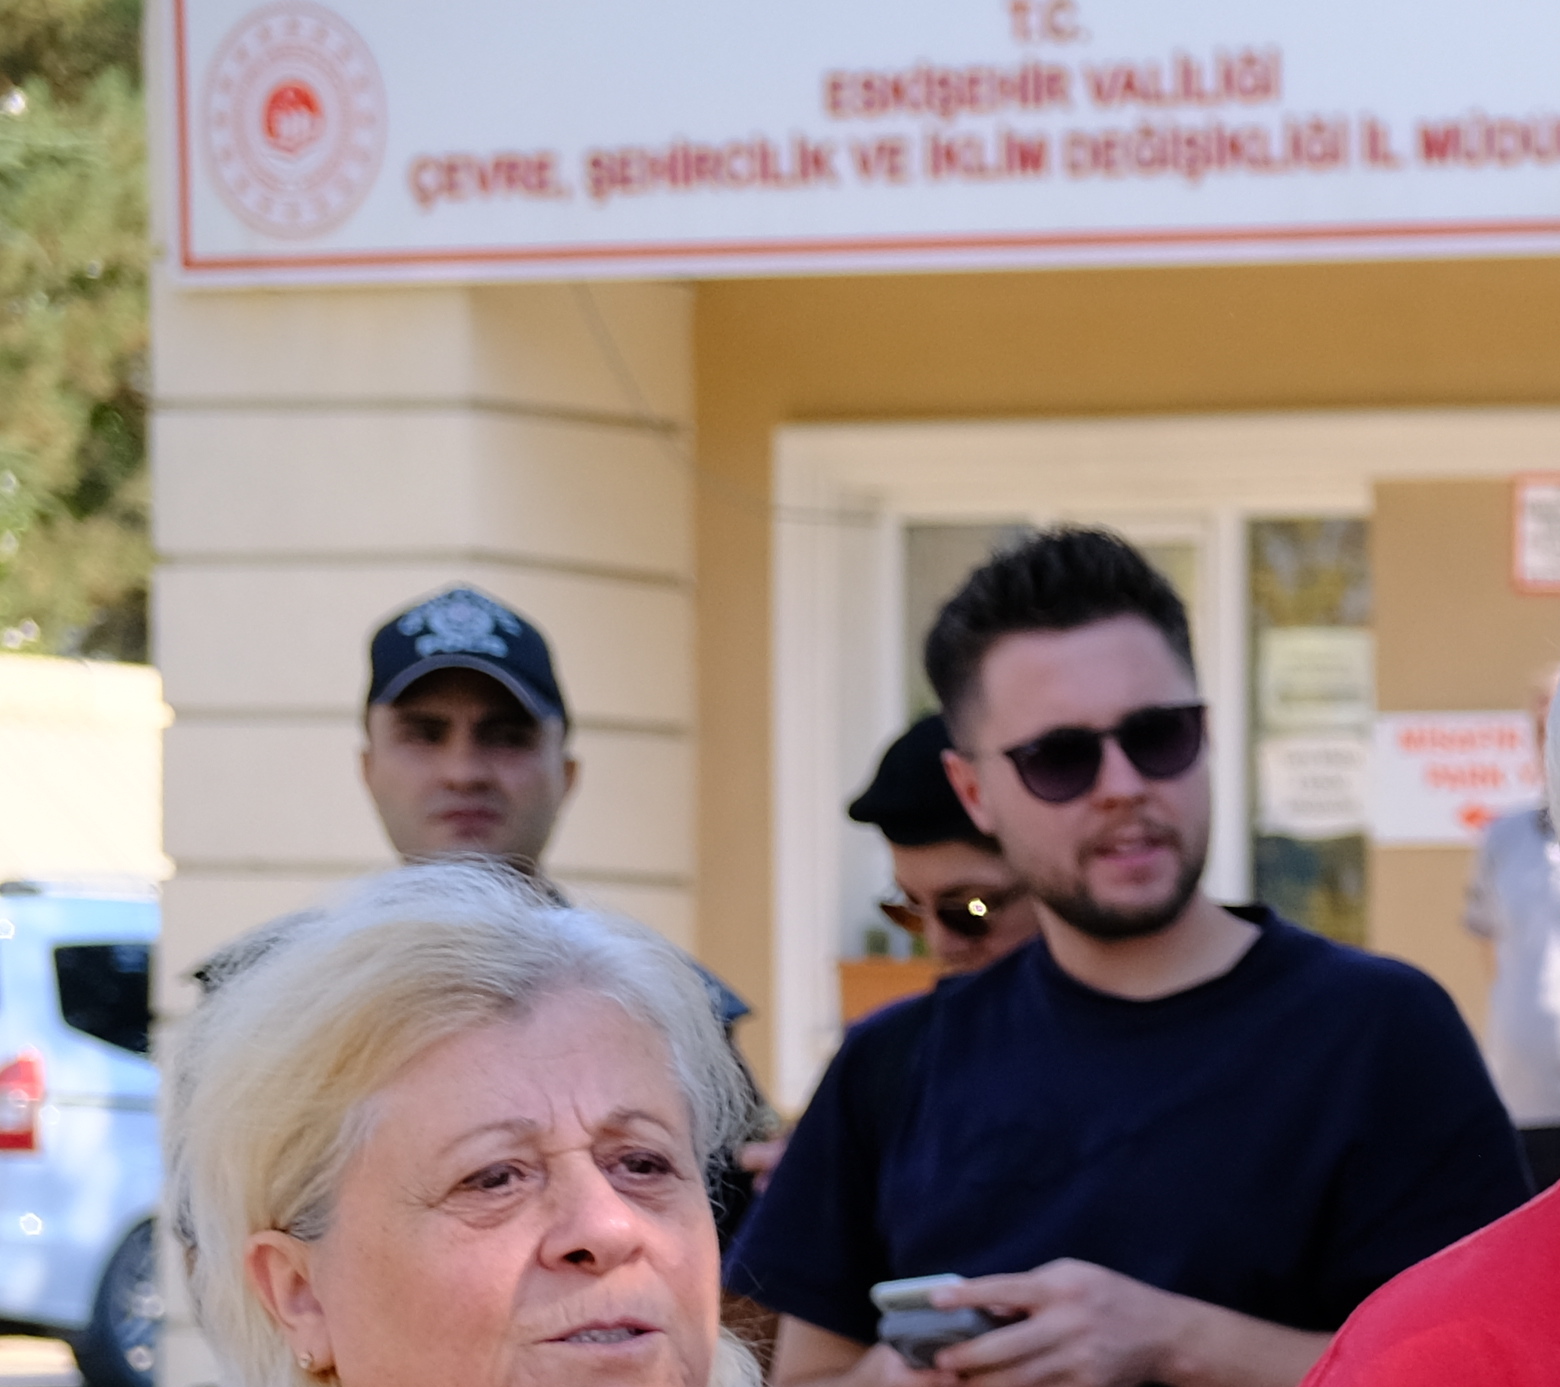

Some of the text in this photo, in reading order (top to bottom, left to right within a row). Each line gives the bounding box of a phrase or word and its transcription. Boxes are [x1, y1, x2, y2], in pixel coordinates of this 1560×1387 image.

[824, 46, 1283, 121] ESKİŞEHİR VALİLİĞİ
[849, 137, 909, 181] VE
[922, 121, 1049, 183] İKLİM
